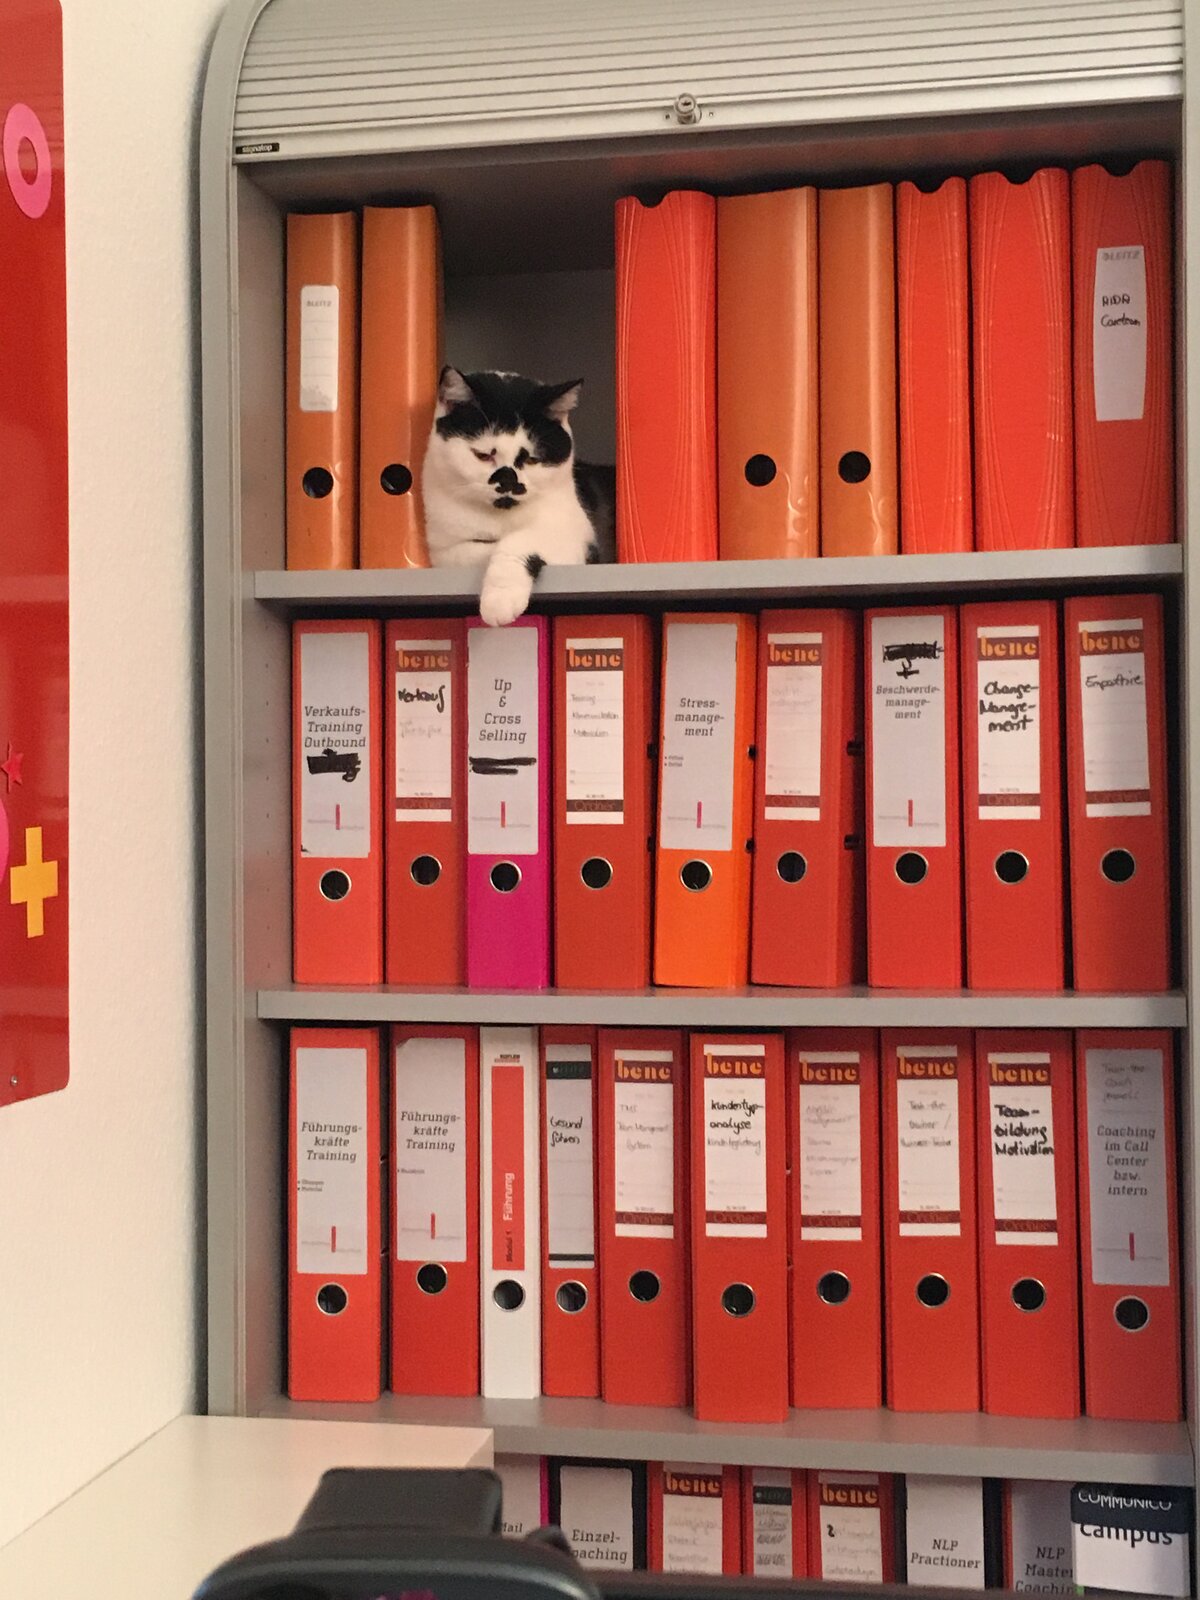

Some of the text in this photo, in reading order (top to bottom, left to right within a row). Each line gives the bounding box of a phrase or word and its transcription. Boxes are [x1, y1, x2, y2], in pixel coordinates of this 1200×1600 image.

[980, 636, 1037, 656] bene
[1081, 630, 1141, 652] bene
[398, 648, 449, 668] bene
[569, 647, 621, 668] bene
[769, 641, 820, 663] bene
[494, 679, 512, 693] Up
[876, 685, 940, 695] Beschwerde-
[498, 695, 507, 707] &
[679, 697, 719, 709] Stress-
[885, 698, 931, 708] manage-
[304, 705, 366, 718] Verkaufs-
[895, 710, 922, 719] ment
[484, 713, 522, 725] Cross
[674, 712, 725, 725] manage-
[988, 714, 1034, 732] ment
[307, 721, 363, 734] Training
[684, 726, 714, 737] ment
[304, 737, 367, 749] Outbound
[479, 730, 527, 744] Selling
[617, 1059, 671, 1080] bene
[707, 1053, 763, 1075] bene
[899, 1055, 955, 1076] bene
[991, 1059, 1048, 1082] bene
[801, 1060, 857, 1082] bene
[400, 1111, 461, 1124] Führungs-
[301, 1121, 362, 1134] Führungs-
[413, 1126, 449, 1137] kräfte
[709, 1117, 752, 1135] analyse
[1097, 1125, 1156, 1139] Coaching
[314, 1136, 350, 1148] kräfte
[406, 1139, 456, 1152] Training
[1104, 1140, 1150, 1152] im Call
[307, 1150, 357, 1163] Training
[1106, 1154, 1149, 1167] Center
[503, 1173, 515, 1221] Führung
[1108, 1185, 1148, 1196] intern
[666, 1471, 721, 1493] bene
[822, 1483, 878, 1504] bene
[572, 1529, 621, 1543] Einzel-
[932, 1539, 959, 1551] NLP
[572, 1547, 628, 1564] oaching
[1036, 1546, 1065, 1559] NLP
[910, 1551, 981, 1569] Practioner
[1015, 1580, 1075, 1595] Coachin
